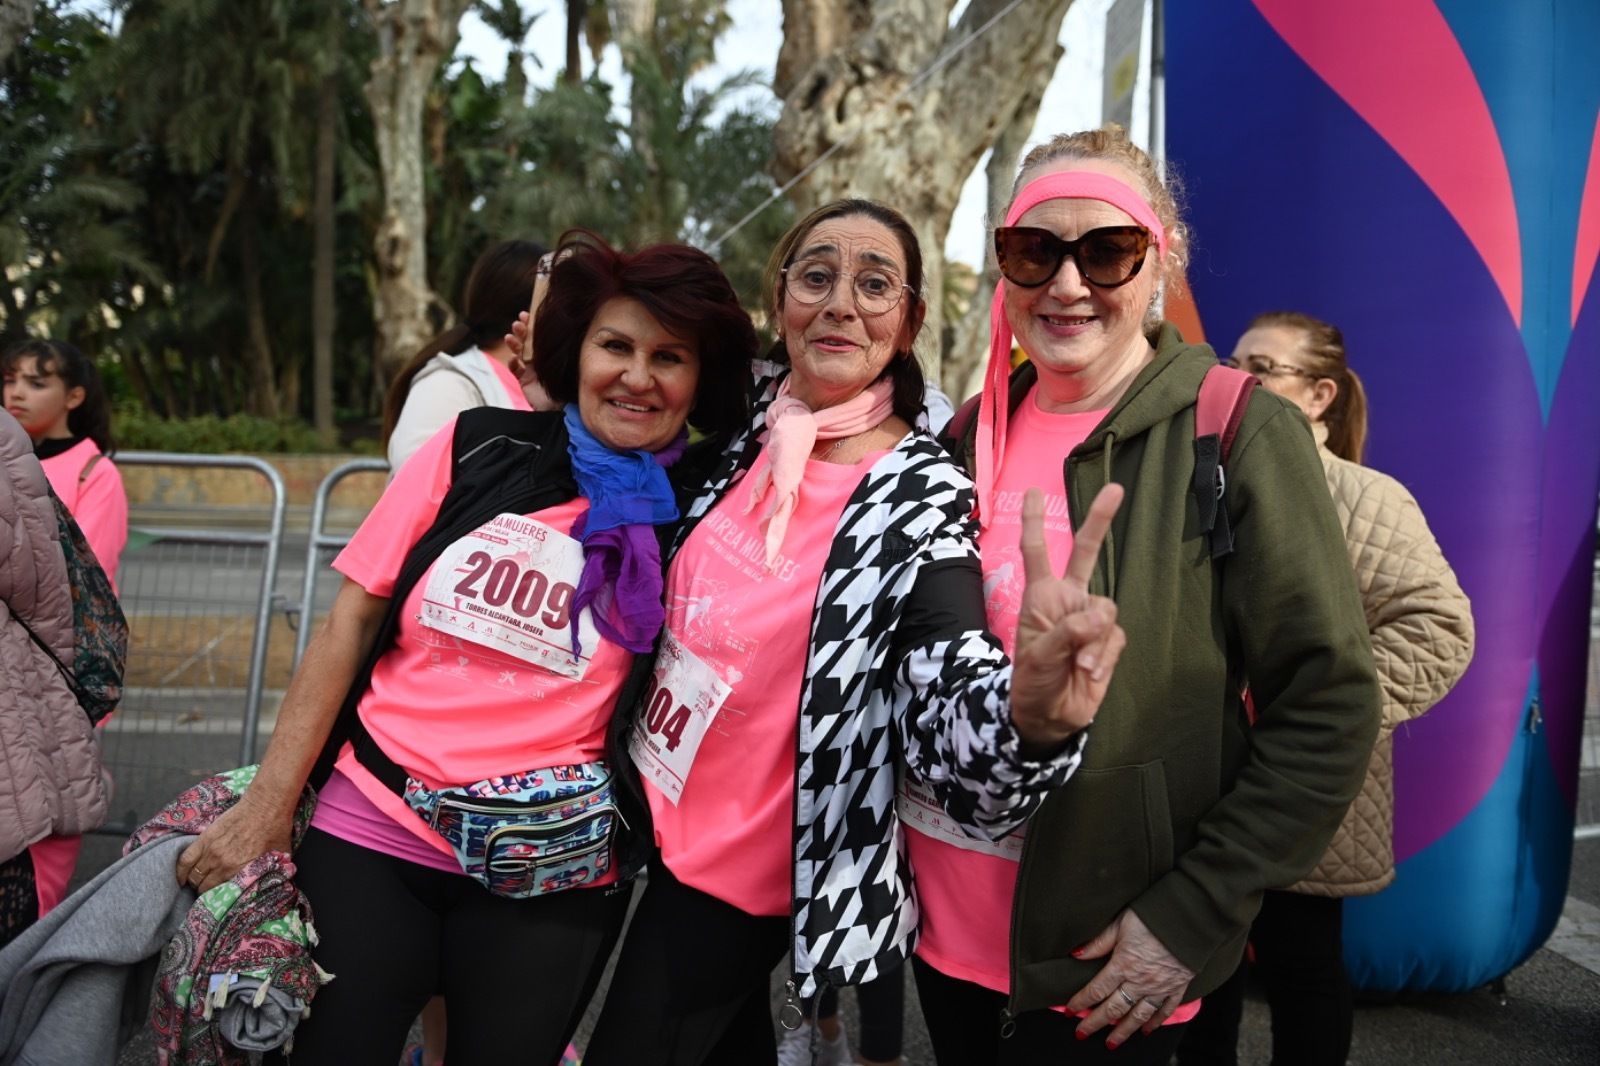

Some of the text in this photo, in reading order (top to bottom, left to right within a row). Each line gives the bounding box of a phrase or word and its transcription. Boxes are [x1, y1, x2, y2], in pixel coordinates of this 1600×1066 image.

[505, 518, 548, 541] MUJERES
[739, 536, 801, 582] MUJRES
[453, 550, 577, 630] 2009
